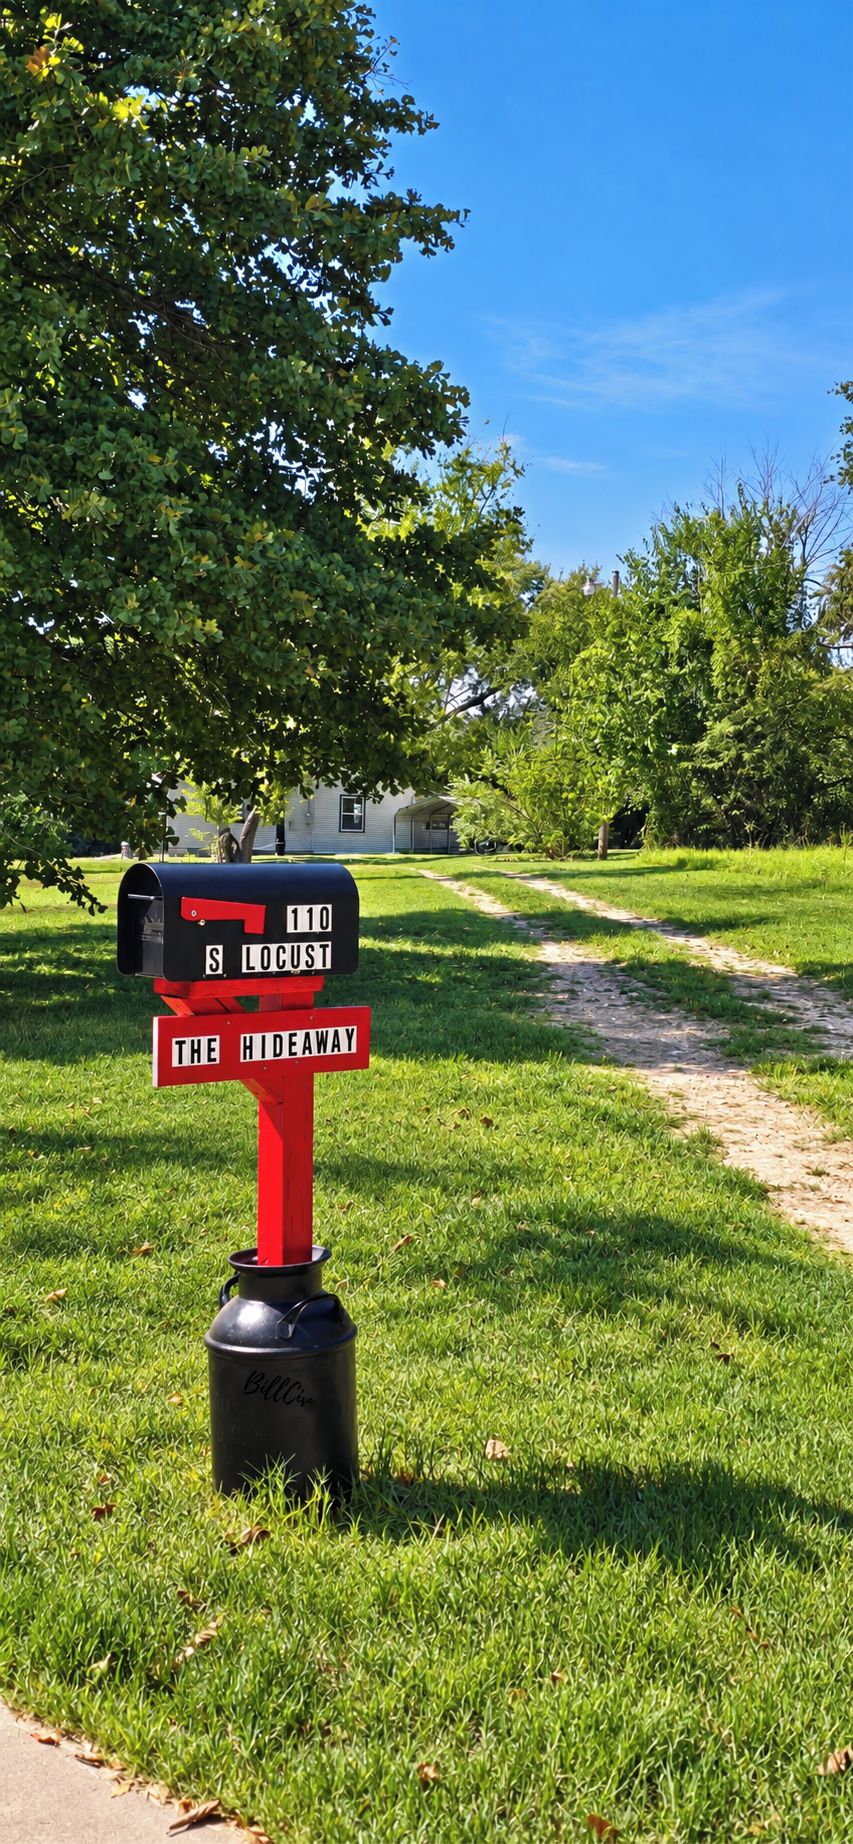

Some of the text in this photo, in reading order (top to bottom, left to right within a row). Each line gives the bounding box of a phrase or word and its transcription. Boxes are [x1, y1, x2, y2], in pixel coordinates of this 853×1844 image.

[291, 905, 330, 931] 110
[209, 943, 329, 972] S LOCUST
[175, 1027, 355, 1064] THE HIDEAWAY
